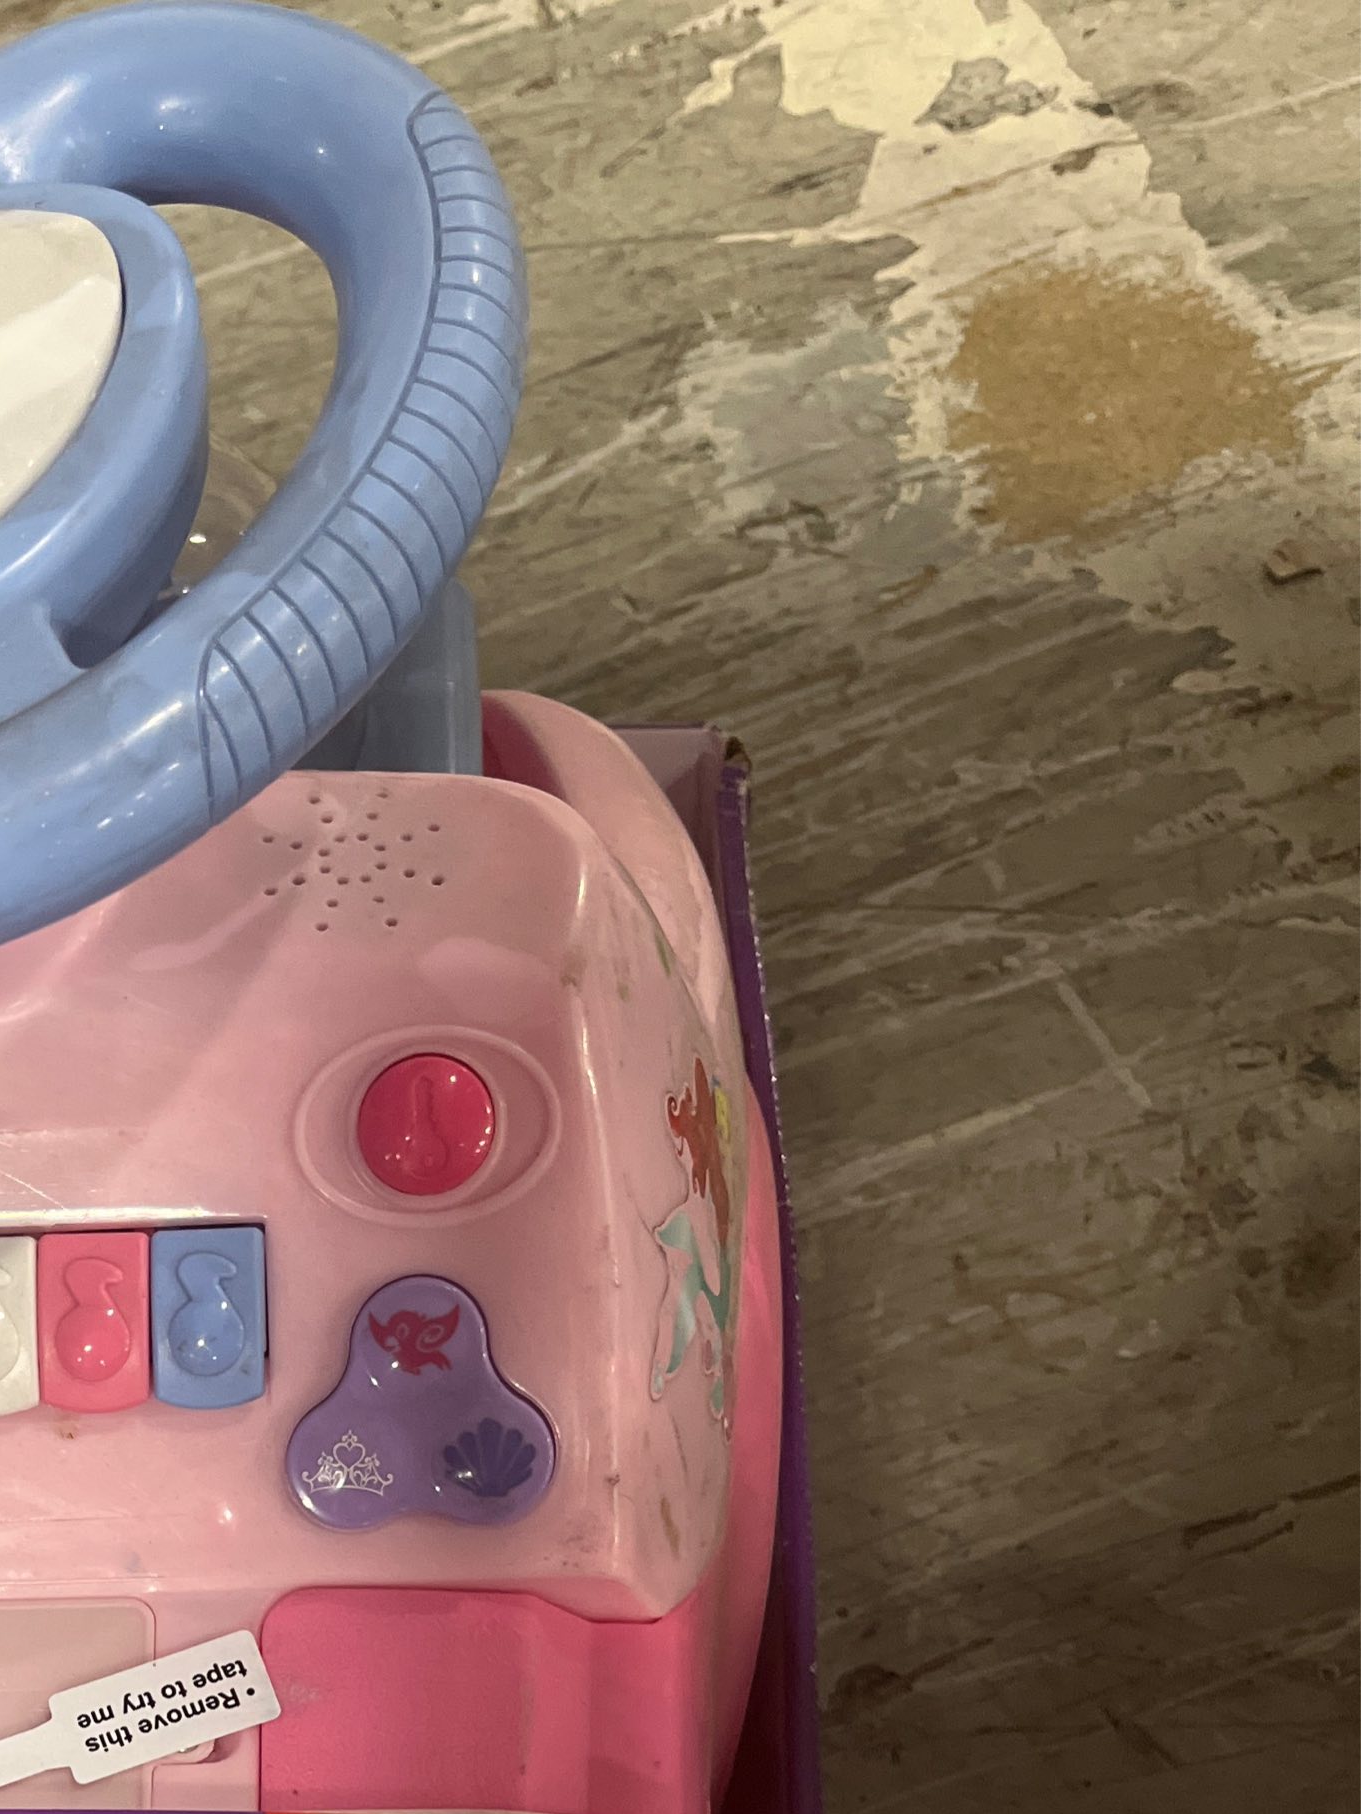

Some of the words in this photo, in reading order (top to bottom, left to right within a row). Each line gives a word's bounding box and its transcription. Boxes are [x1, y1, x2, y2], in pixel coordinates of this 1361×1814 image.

[192, 1660, 248, 1688] tape
[122, 1692, 156, 1714] try
[161, 1680, 188, 1701] to
[77, 1705, 115, 1728] me
[138, 1687, 241, 1733] Remove
[85, 1725, 133, 1752] this
